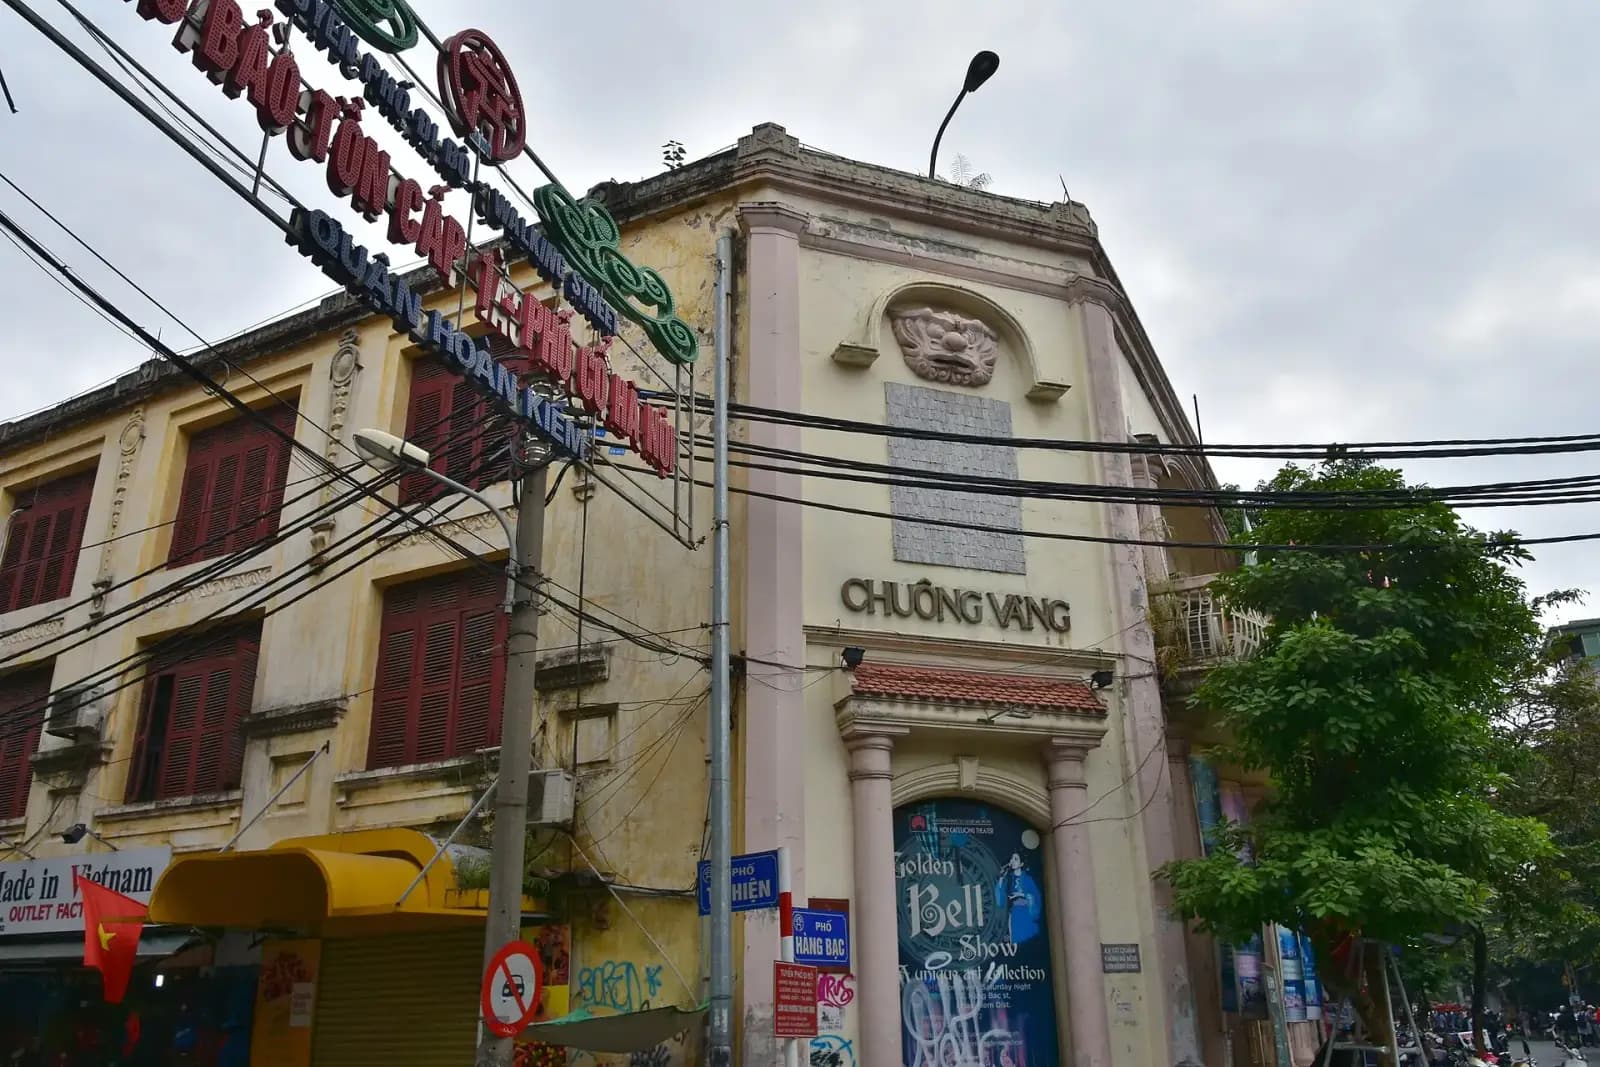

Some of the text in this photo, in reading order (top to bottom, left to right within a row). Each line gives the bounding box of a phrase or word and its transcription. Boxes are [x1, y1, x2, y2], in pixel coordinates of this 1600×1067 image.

[199, 0, 300, 130] BẢO
[491, 188, 566, 279] WALKING
[568, 271, 620, 335] STREET
[840, 577, 984, 625] CHUÔNG
[732, 862, 755, 877] PHỐ
[0, 868, 35, 902] ade
[39, 867, 59, 900] in
[732, 878, 771, 903] HIỆN
[9, 903, 53, 923] OUTLET
[907, 883, 984, 939] Bell
[815, 919, 832, 932] PHỐ
[795, 932, 845, 960] HÀNG BẠC
[959, 933, 1018, 961] Show
